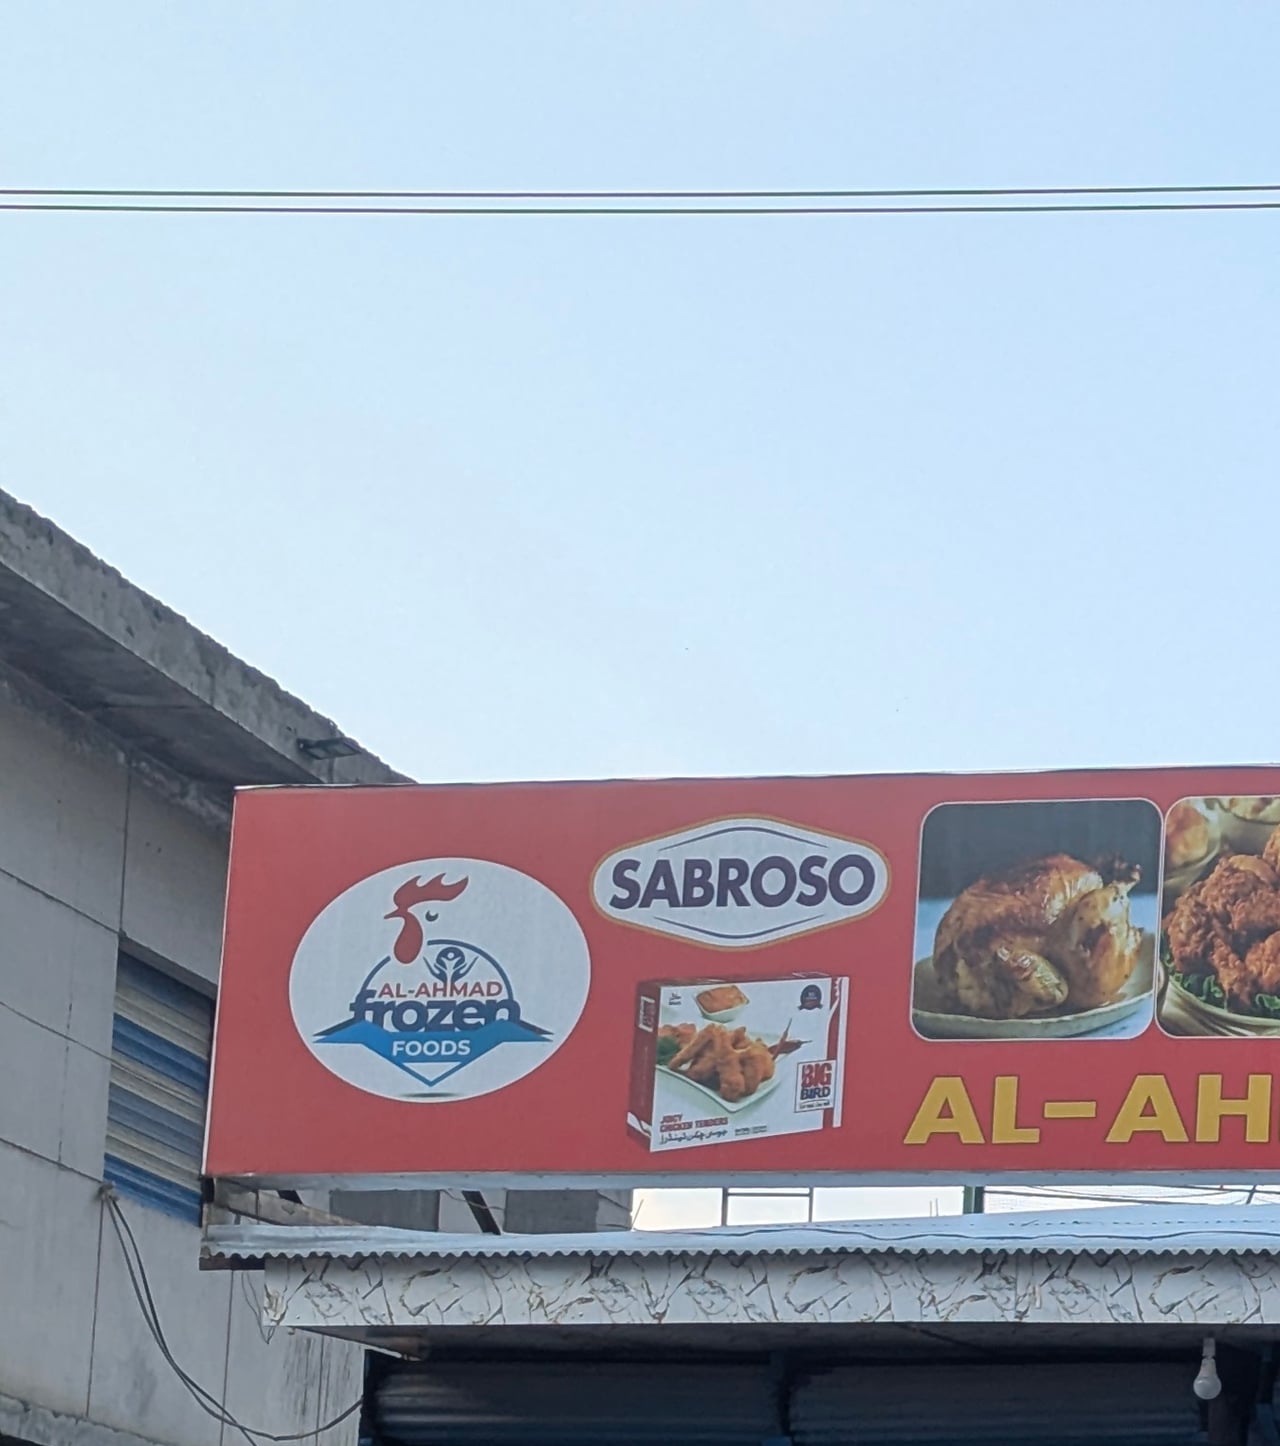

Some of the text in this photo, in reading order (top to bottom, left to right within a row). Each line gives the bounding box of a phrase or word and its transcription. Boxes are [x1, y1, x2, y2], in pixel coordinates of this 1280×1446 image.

[608, 854, 876, 909] SABROSO
[377, 981, 503, 999] AL-AHMAD
[349, 988, 521, 1034] frozen
[392, 1038, 471, 1058] FOODS
